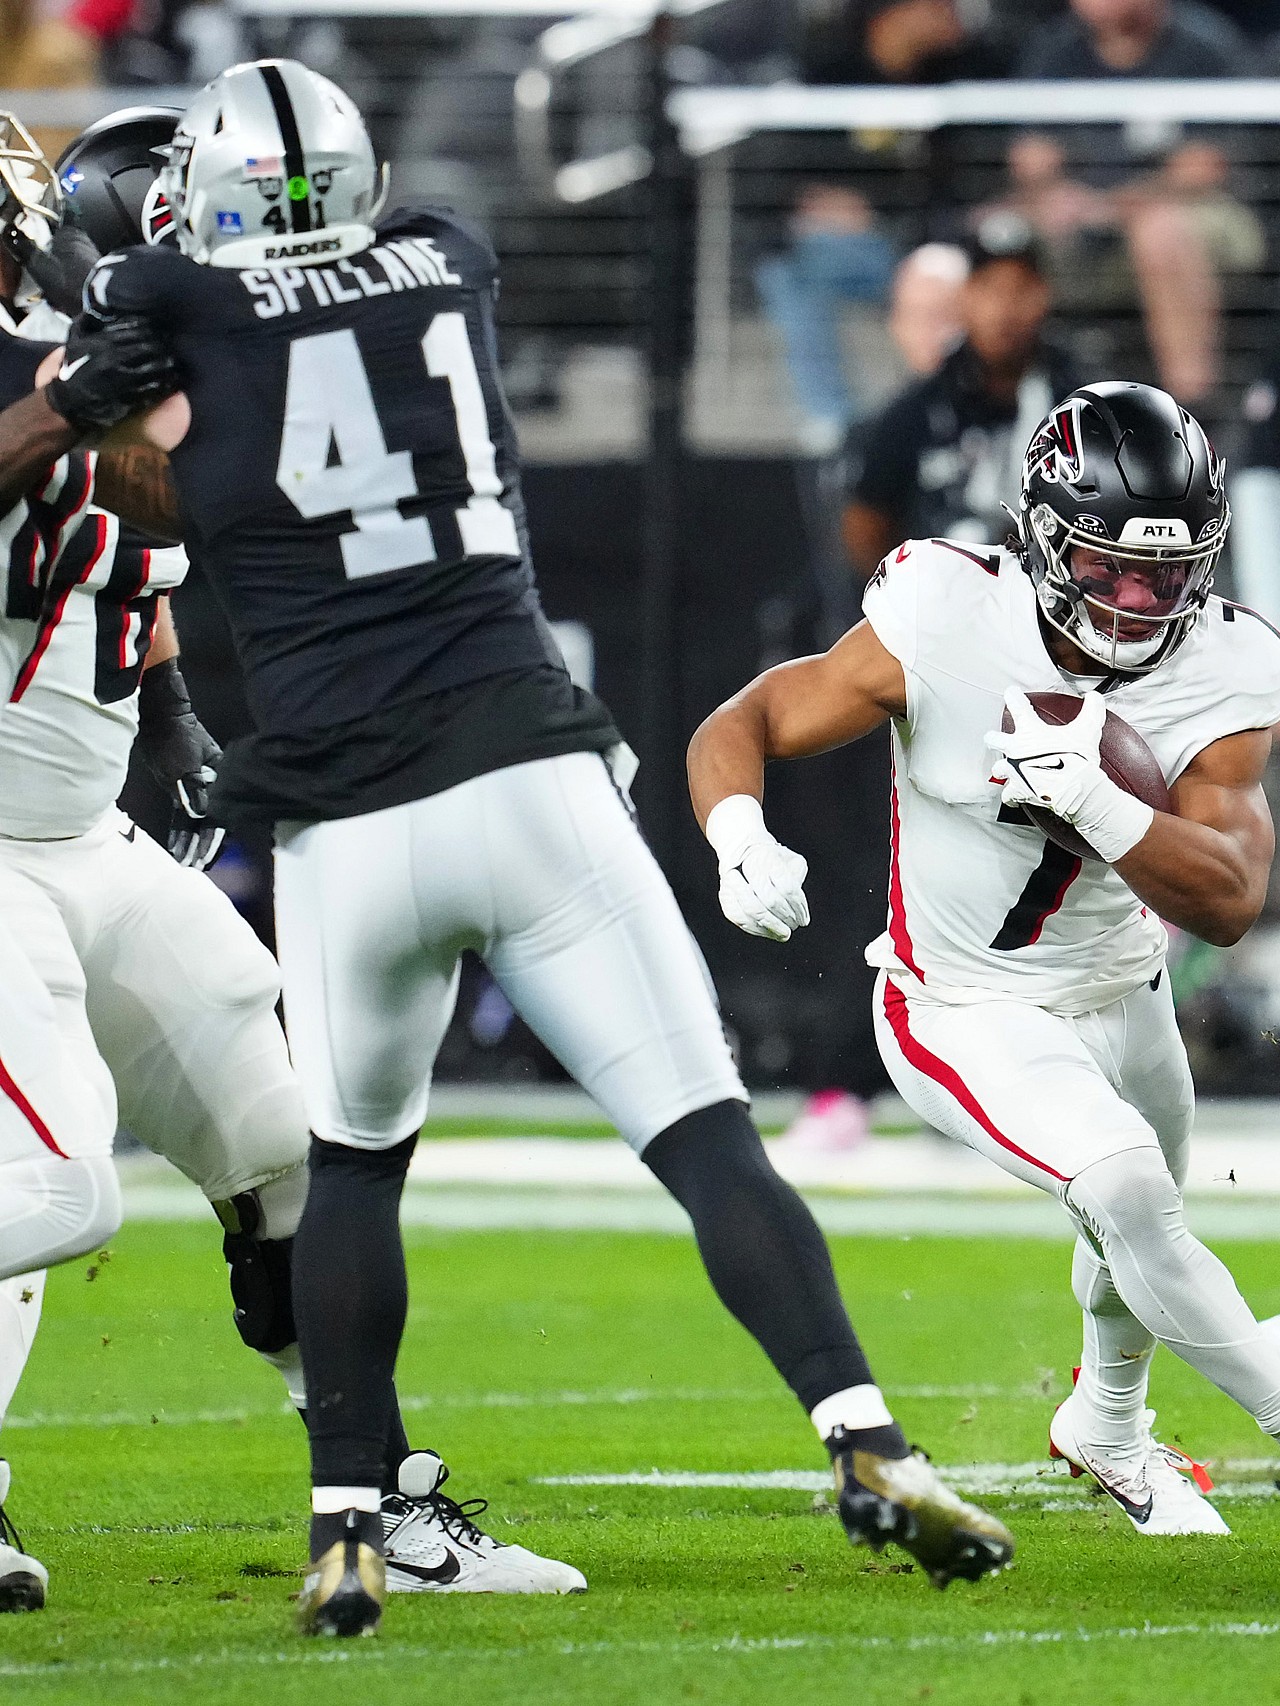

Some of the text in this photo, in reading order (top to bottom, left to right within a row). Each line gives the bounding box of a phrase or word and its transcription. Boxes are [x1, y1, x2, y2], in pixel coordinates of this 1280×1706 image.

[238, 236, 463, 320] SPILLANE
[276, 312, 521, 580] 41
[1142, 526, 1177, 537] ATL
